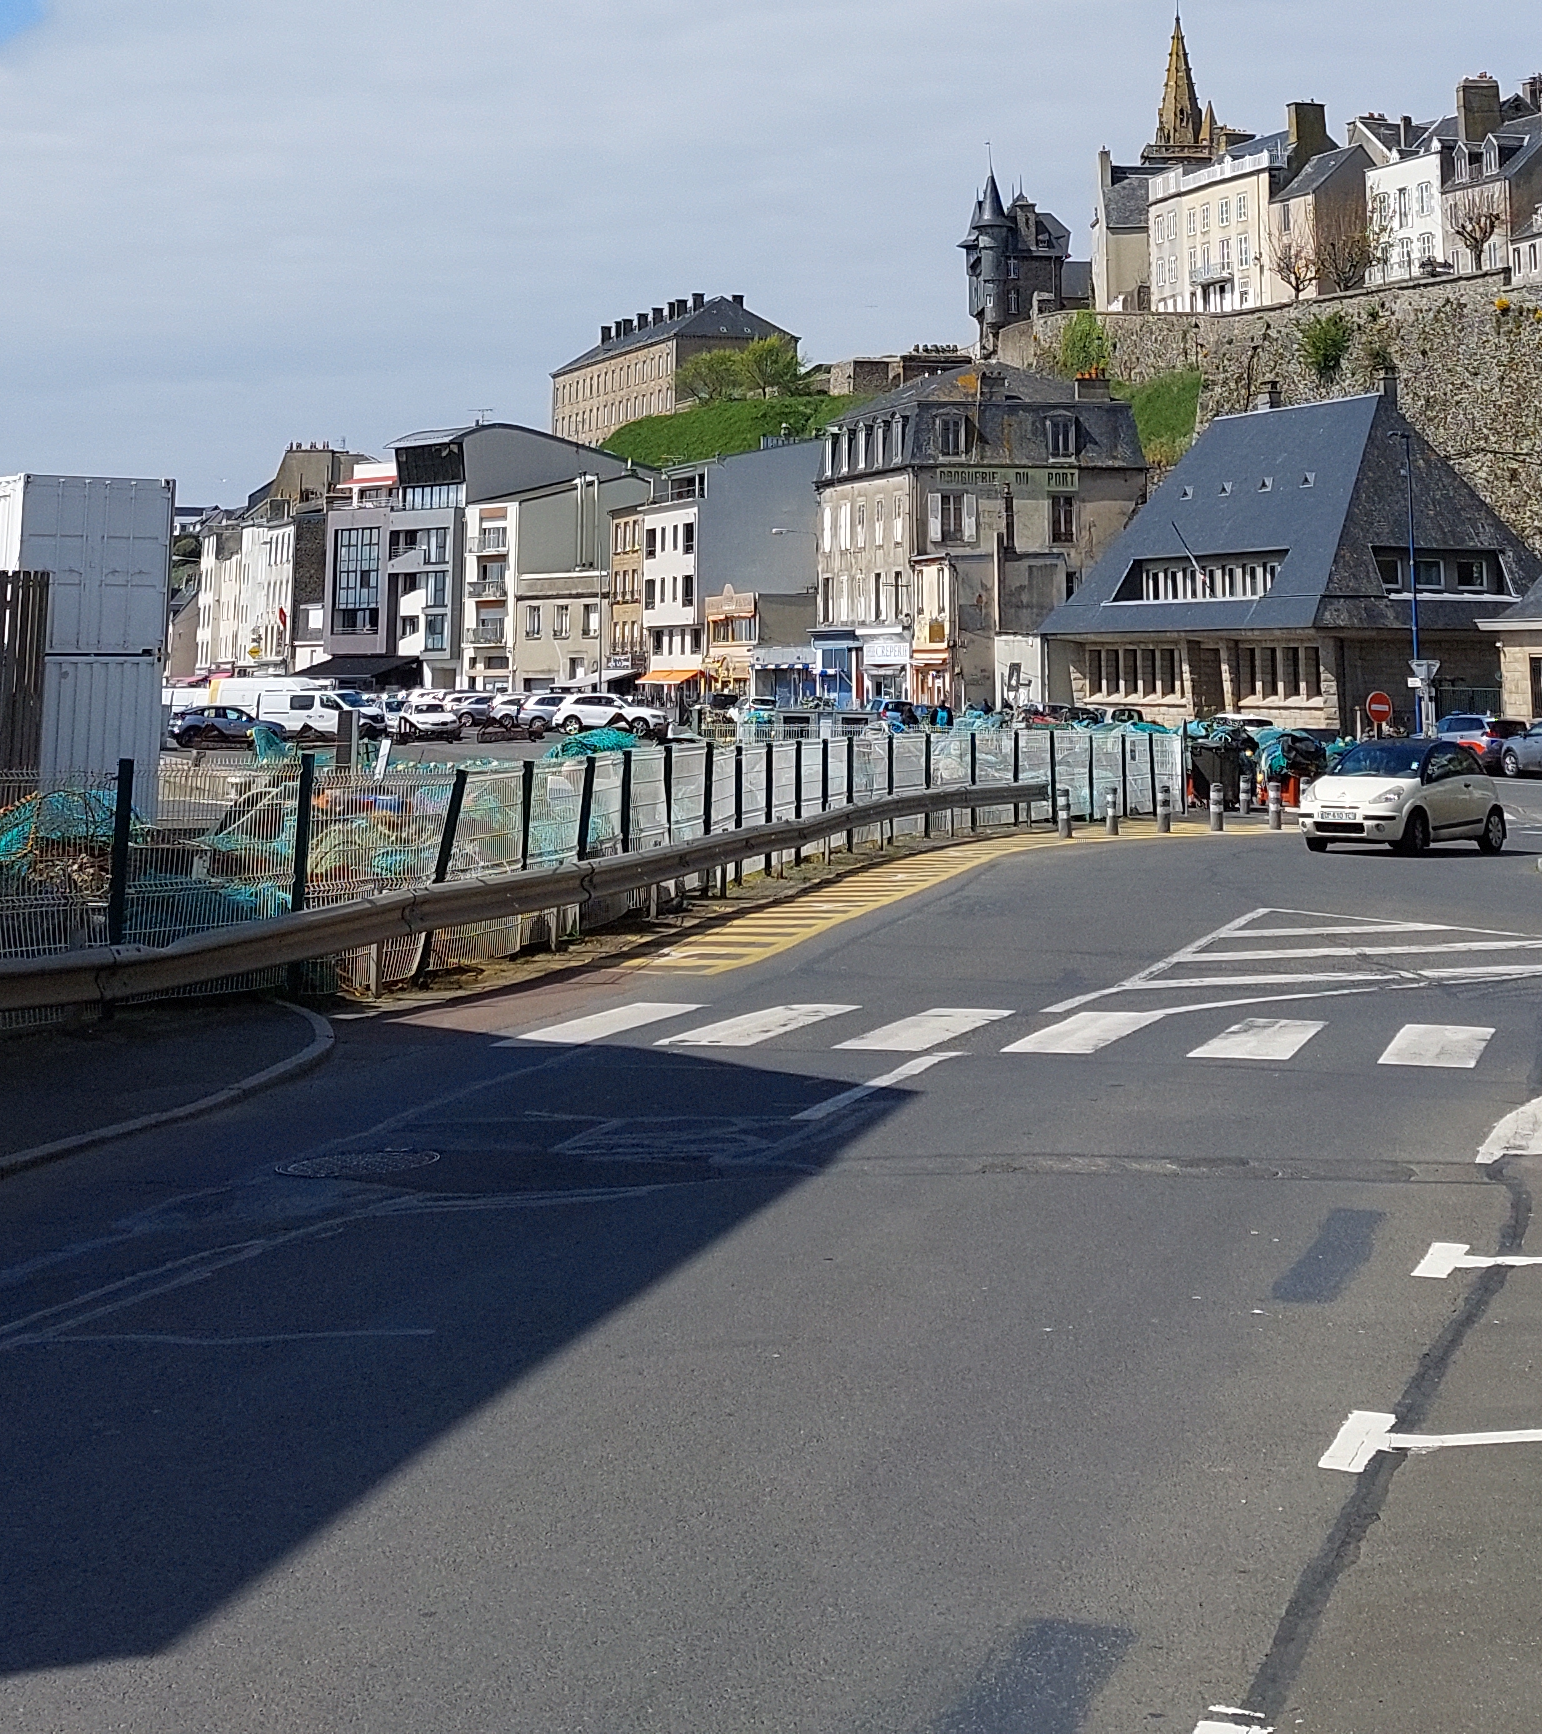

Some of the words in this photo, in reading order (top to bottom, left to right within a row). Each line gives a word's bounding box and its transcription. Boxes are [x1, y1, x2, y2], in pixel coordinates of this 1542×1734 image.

[939, 469, 999, 485] DROGUERIE
[1015, 471, 1030, 485] DU
[1047, 472, 1076, 487] PORT
